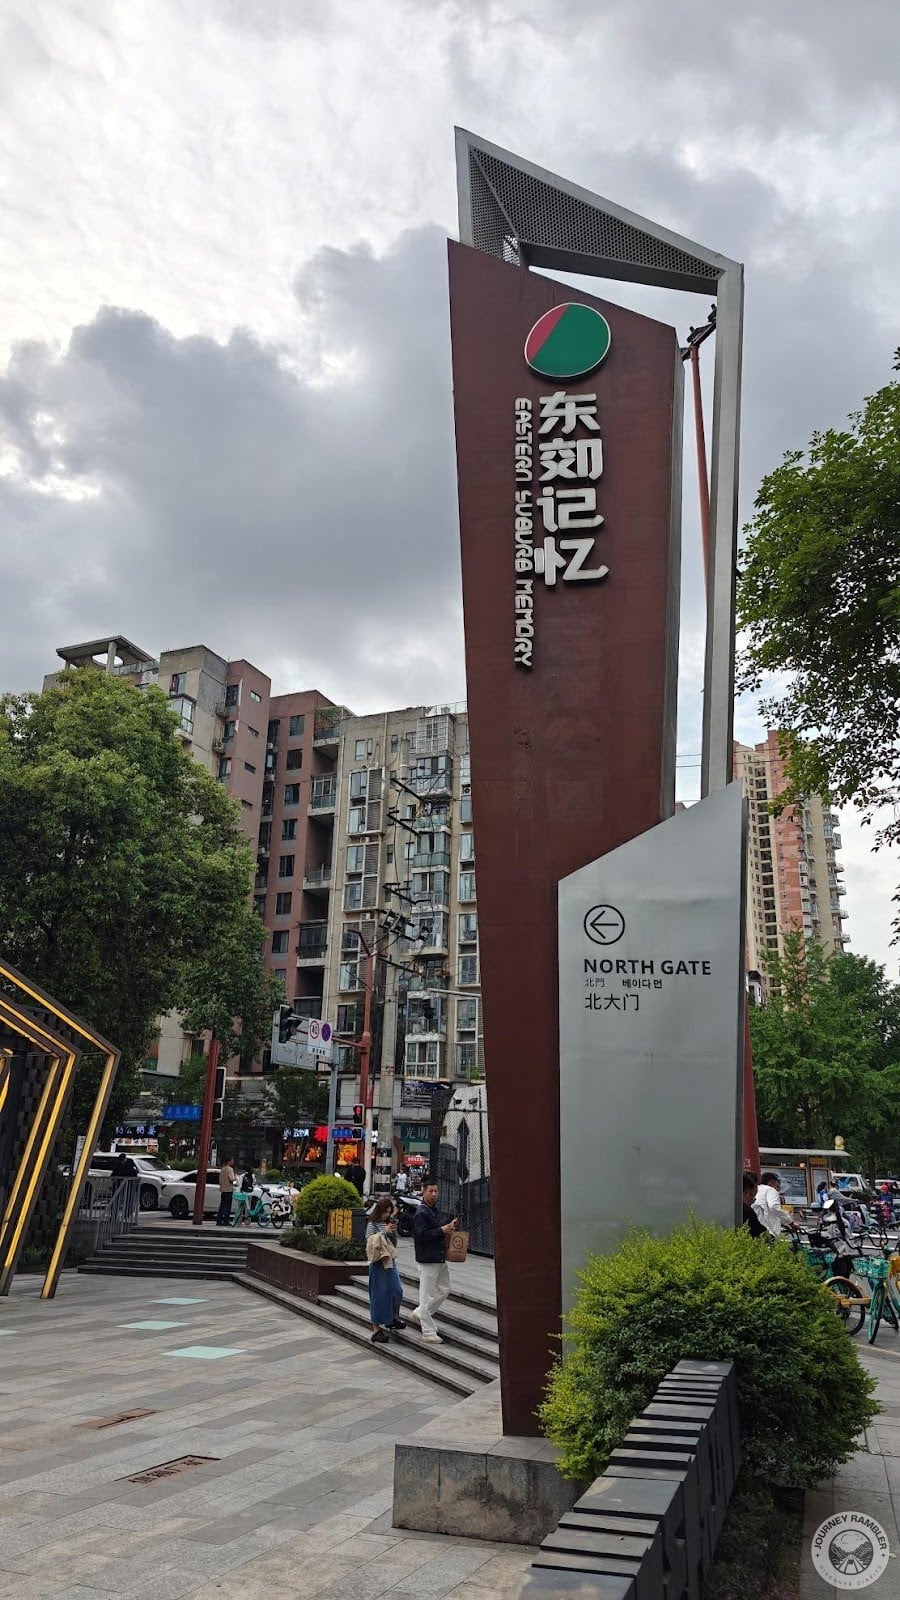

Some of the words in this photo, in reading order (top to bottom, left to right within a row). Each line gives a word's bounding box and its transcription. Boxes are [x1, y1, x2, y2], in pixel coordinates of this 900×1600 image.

[514, 397, 533, 482] EASTERN
[533, 391, 610, 586] 东郊记忆
[514, 490, 533, 573] SUBURB
[514, 579, 534, 667] MEMORY
[584, 958, 654, 975] NORTH
[660, 960, 712, 976] GATE
[584, 977, 605, 988] 北門
[585, 993, 640, 1011] 北大门
